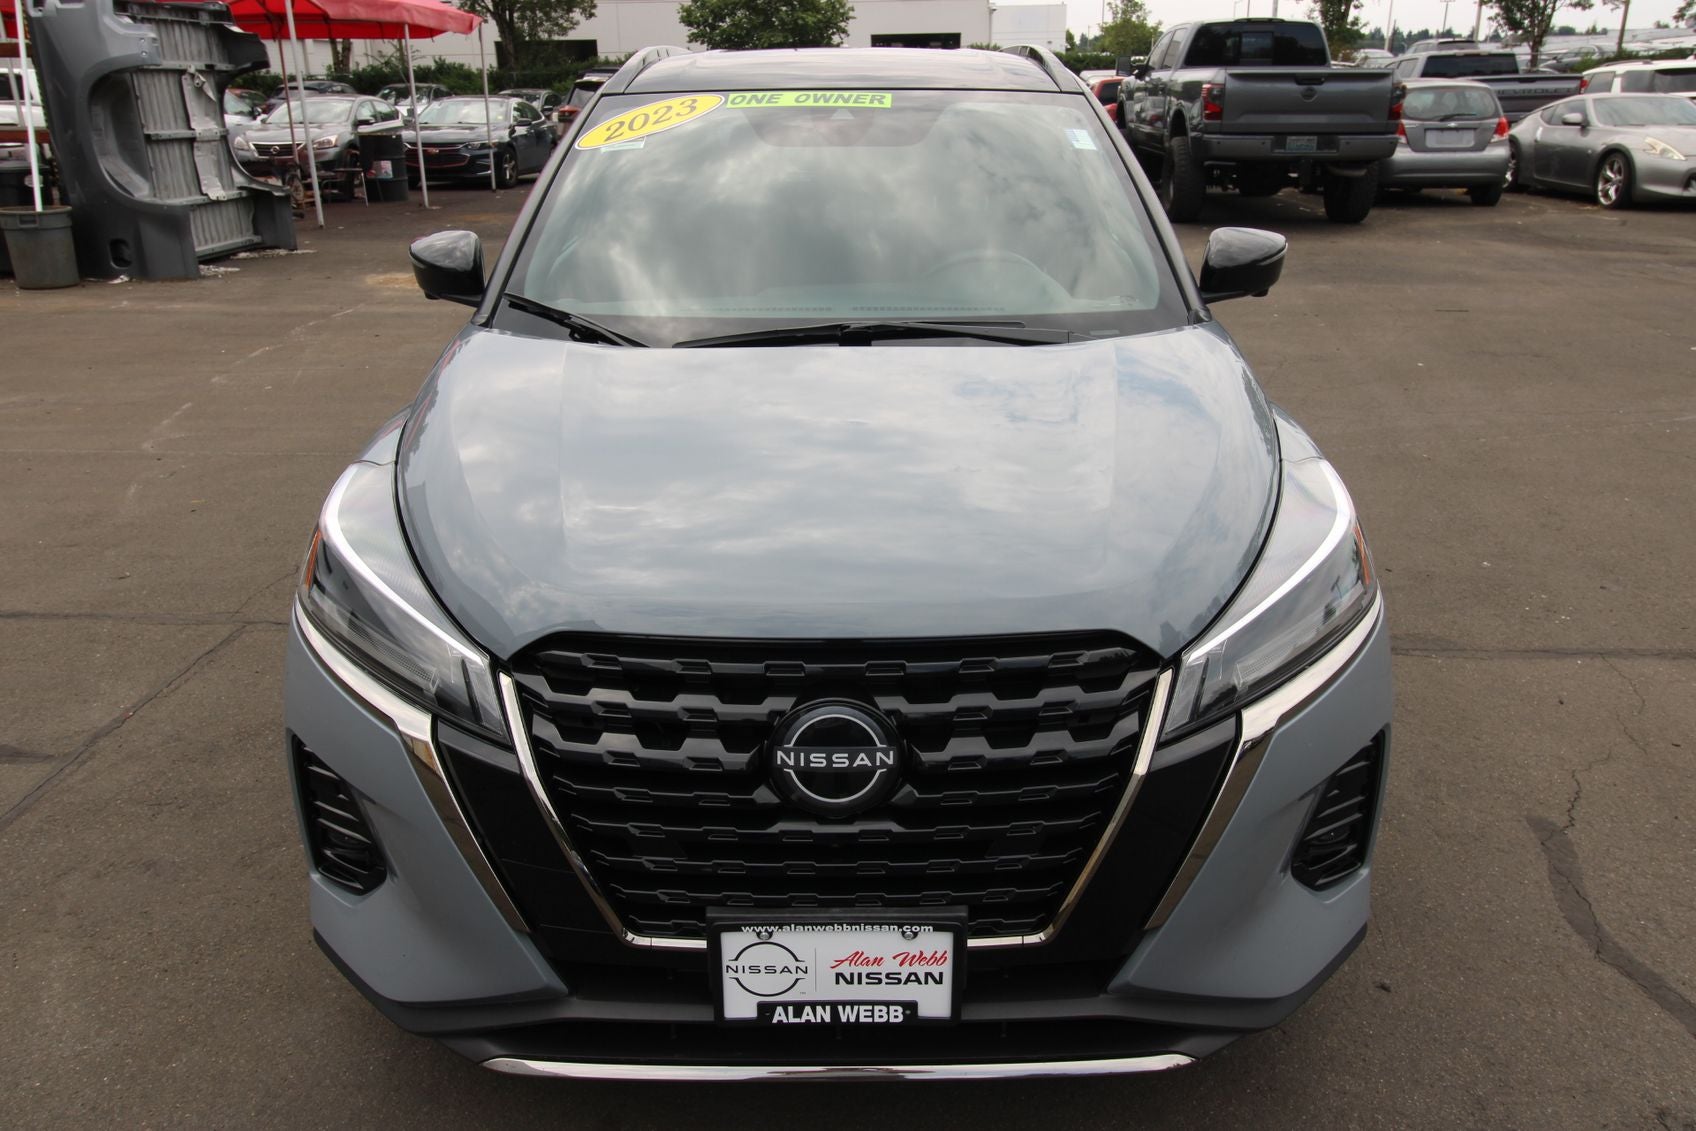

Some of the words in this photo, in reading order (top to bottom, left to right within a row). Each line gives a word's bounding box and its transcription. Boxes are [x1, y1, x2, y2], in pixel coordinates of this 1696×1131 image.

[729, 93, 785, 106] ONE
[793, 92, 887, 105] OWNER
[603, 98, 698, 142] 2023
[776, 750, 894, 768] NISSAN
[741, 923, 934, 933] www.alanwebbnissan.com
[830, 950, 884, 969] Alan
[892, 950, 949, 967] Webb
[725, 964, 809, 975] NISSAN
[834, 971, 944, 986] NISSAN
[771, 1005, 832, 1024] ALAN
[837, 1005, 904, 1023] WEBB
